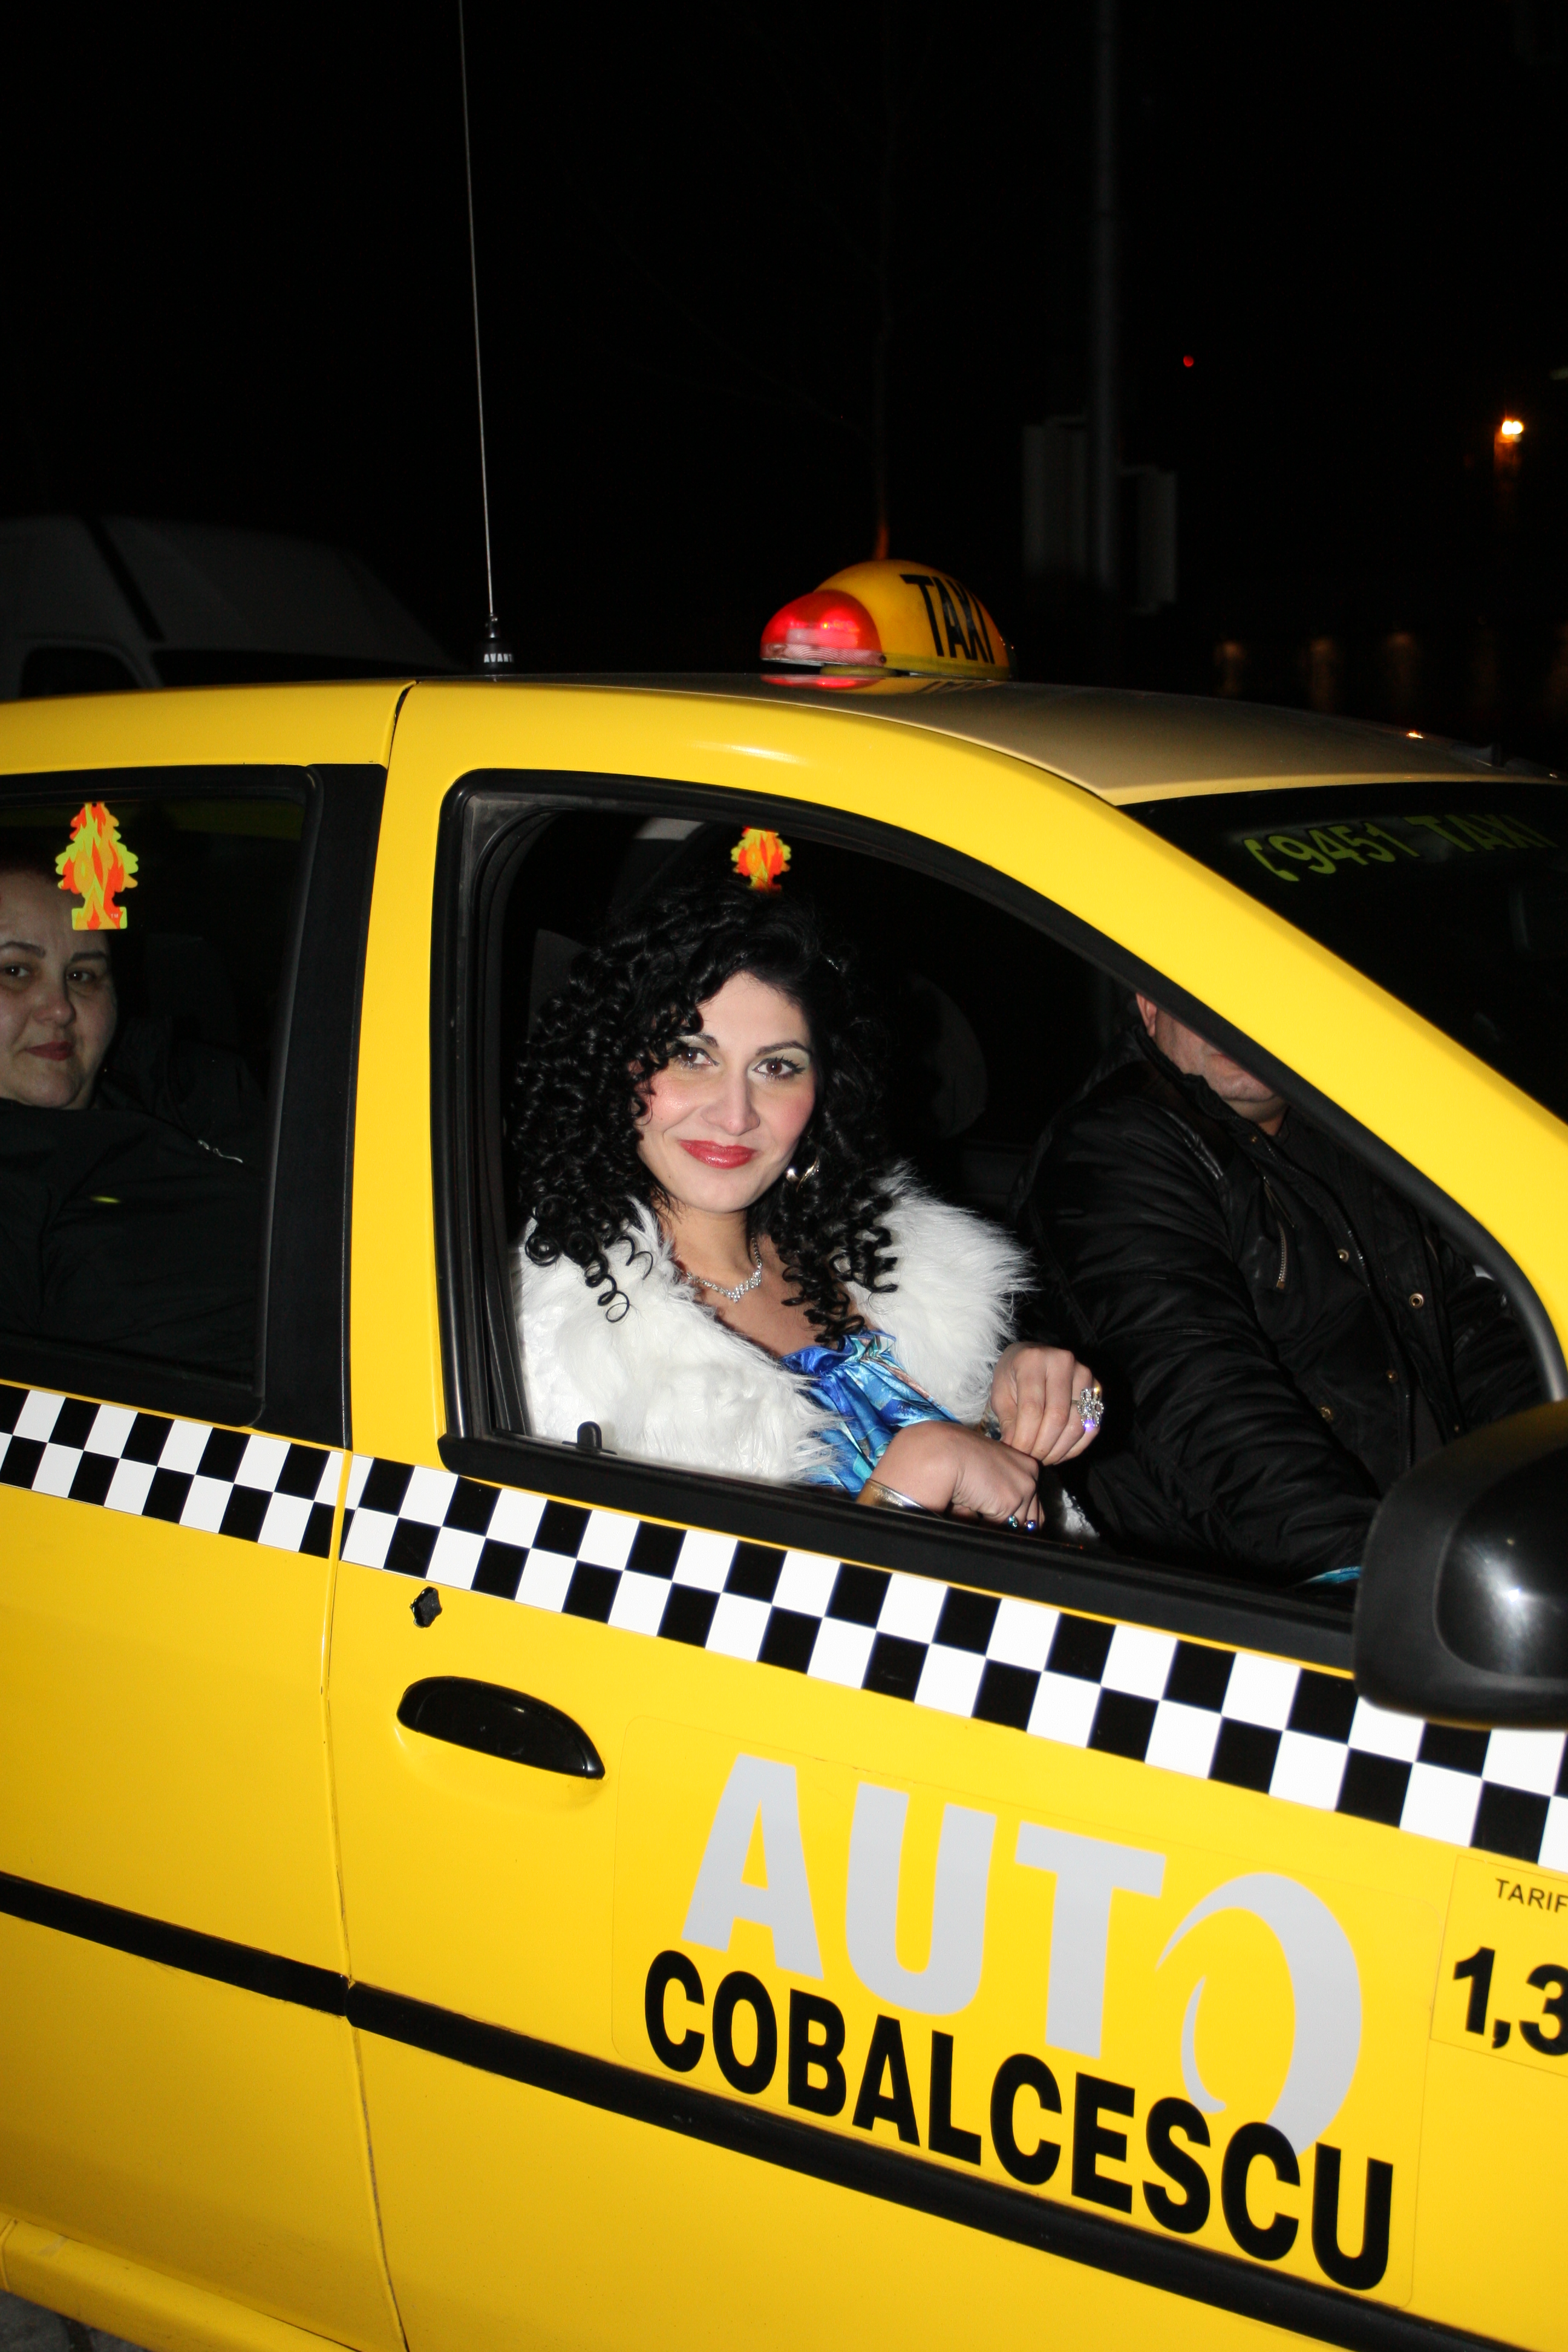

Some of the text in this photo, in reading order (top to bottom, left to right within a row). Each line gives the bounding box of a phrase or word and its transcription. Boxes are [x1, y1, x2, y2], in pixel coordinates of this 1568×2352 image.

[900, 574, 995, 665] TAXI
[1269, 814, 1559, 874] 9451 TAXI
[681, 1752, 1362, 2160] AUTO
[645, 1950, 1394, 2291] COBALCESCU
